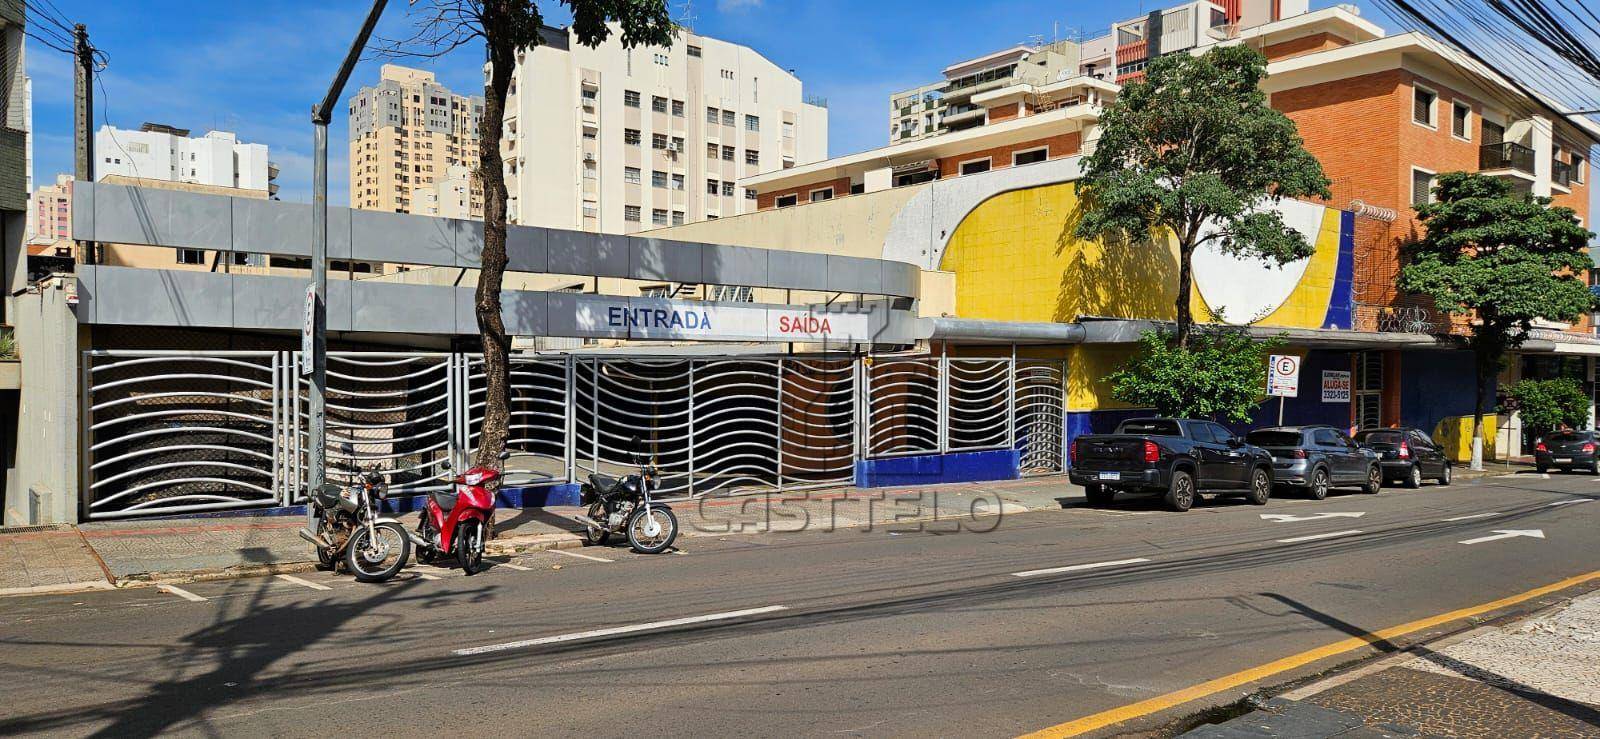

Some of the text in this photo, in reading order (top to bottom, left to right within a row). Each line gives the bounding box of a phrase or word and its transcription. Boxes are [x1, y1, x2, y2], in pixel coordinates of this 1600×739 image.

[608, 306, 712, 330] ENTRADA
[779, 314, 832, 334] SAÍDA
[1282, 361, 1290, 372] E
